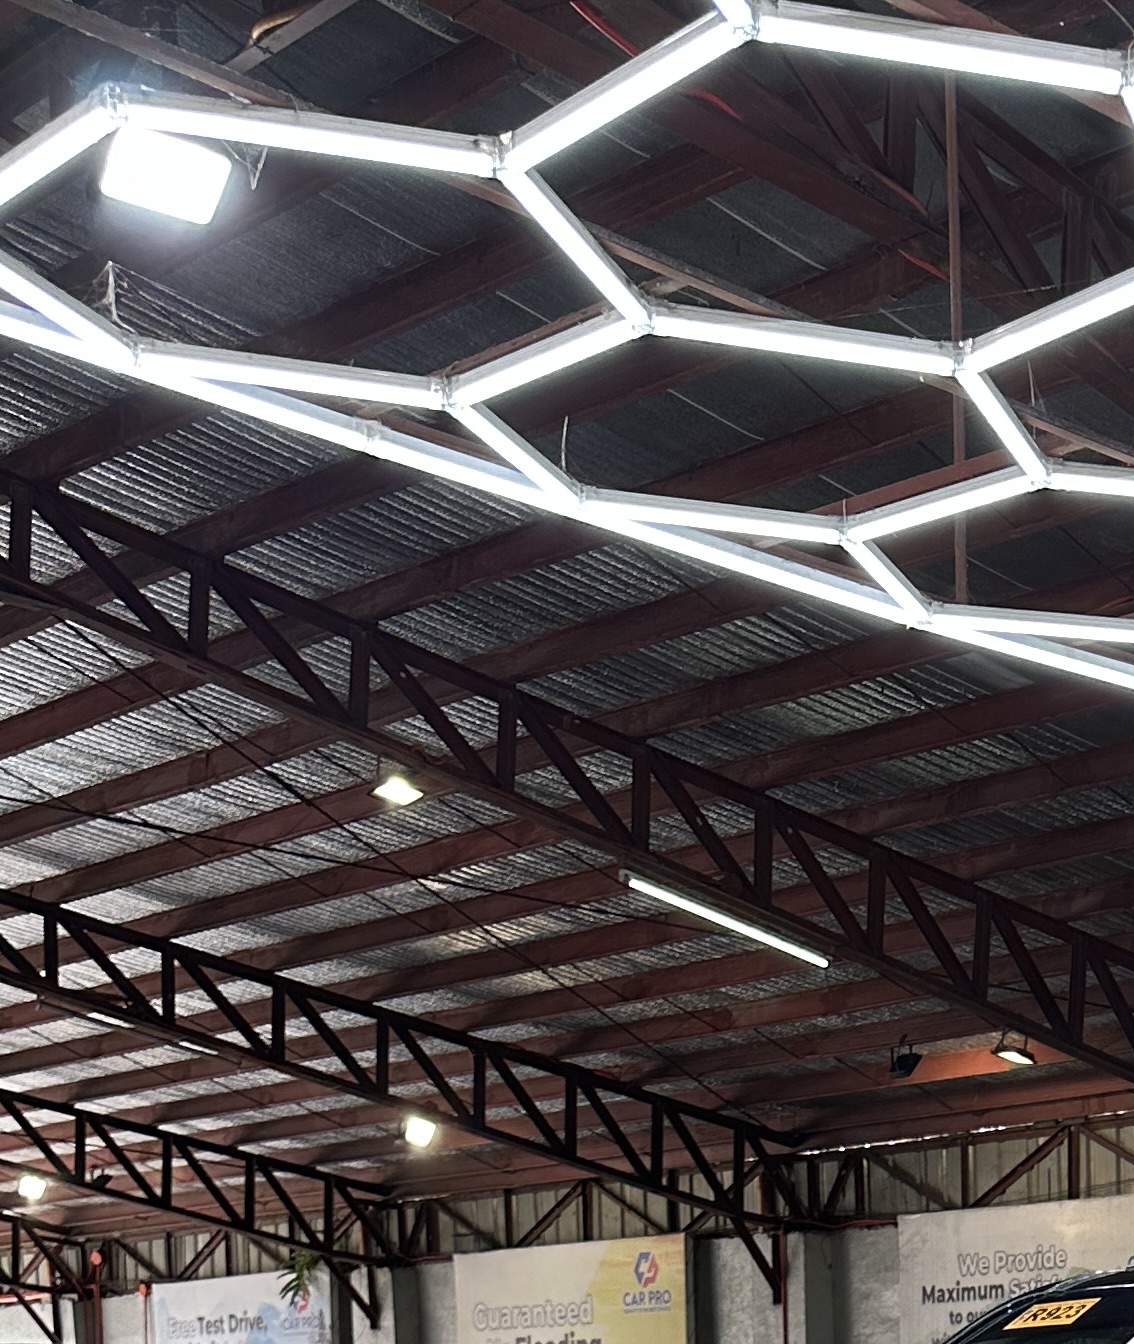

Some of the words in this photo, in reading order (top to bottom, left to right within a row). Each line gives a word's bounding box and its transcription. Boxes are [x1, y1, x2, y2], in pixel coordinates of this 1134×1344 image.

[958, 1252, 990, 1277] We
[994, 1244, 1068, 1275] Provide
[623, 1291, 646, 1306] CAR
[648, 1289, 672, 1305] PRO
[922, 1281, 1004, 1304] Maximum
[197, 1315, 225, 1336] Test
[228, 1310, 268, 1335] Drive,
[473, 1293, 594, 1332] Guaranteed
[949, 1311, 963, 1325] to
[1023, 1304, 1087, 1322] R923
